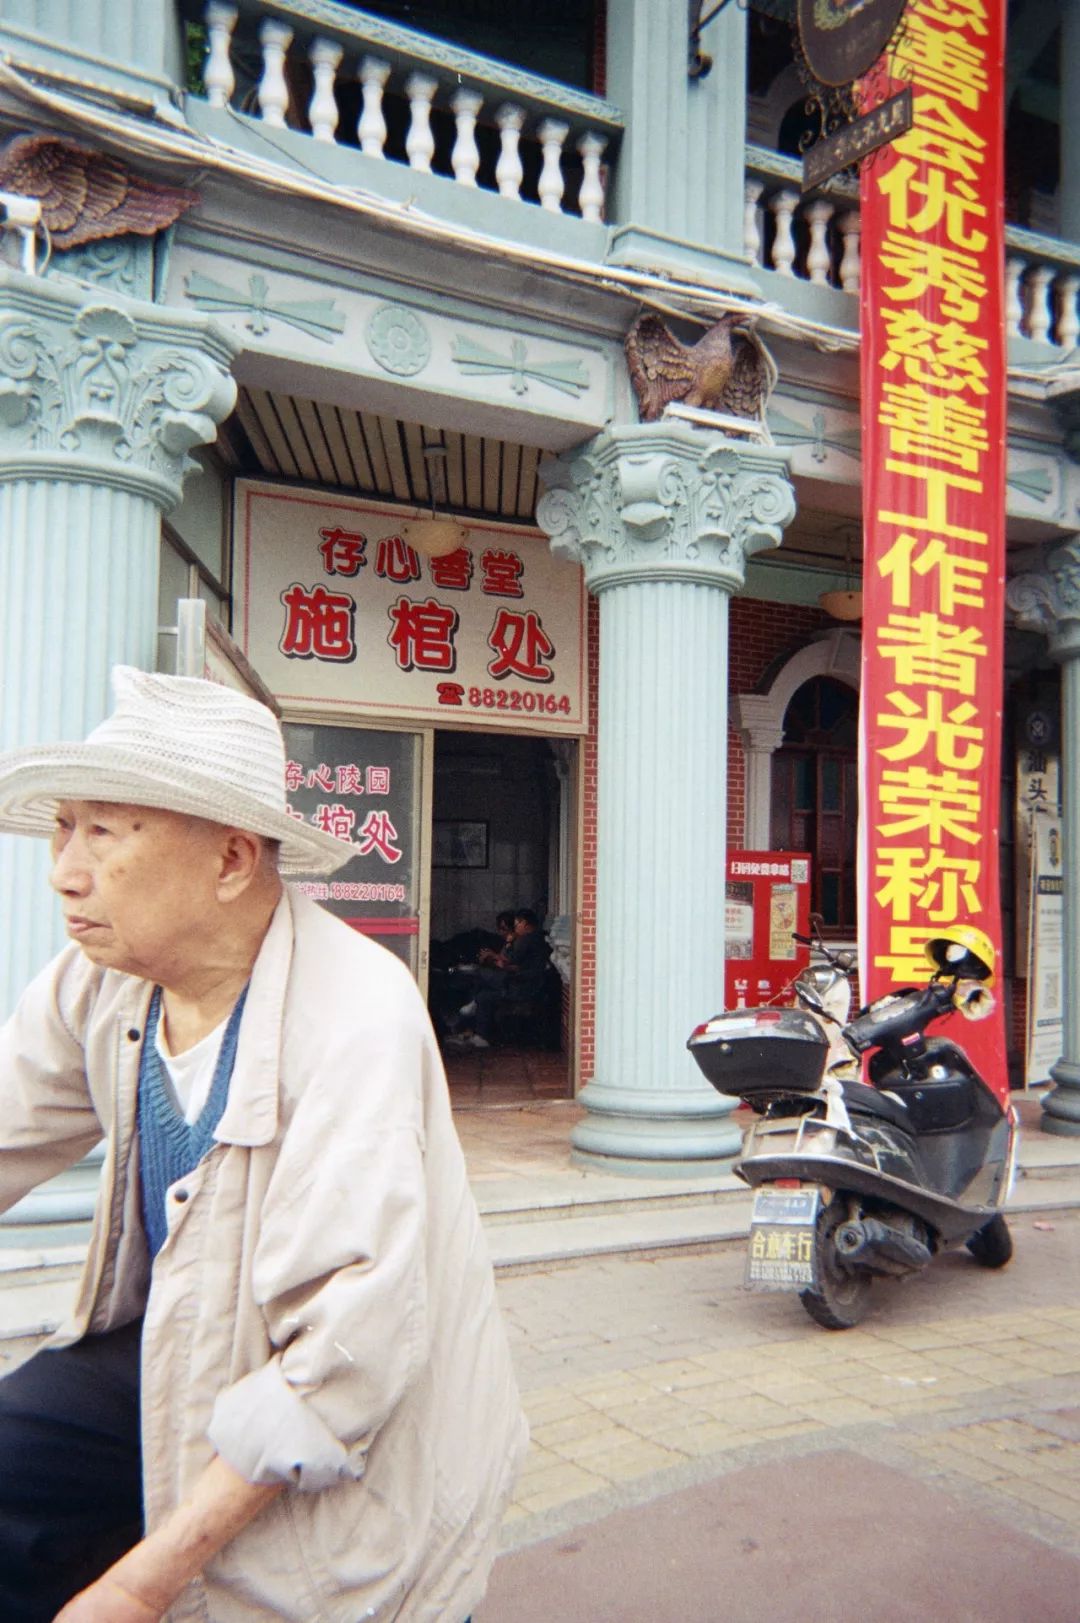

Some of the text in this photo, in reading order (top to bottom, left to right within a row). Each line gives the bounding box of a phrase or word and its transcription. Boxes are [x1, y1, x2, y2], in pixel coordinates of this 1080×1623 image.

[320, 526, 523, 598] 存心善堂
[280, 583, 555, 683] 施棺处
[467, 687, 571, 715] 88220164
[285, 760, 390, 795] 存心陵园
[286, 804, 402, 863] 棺处
